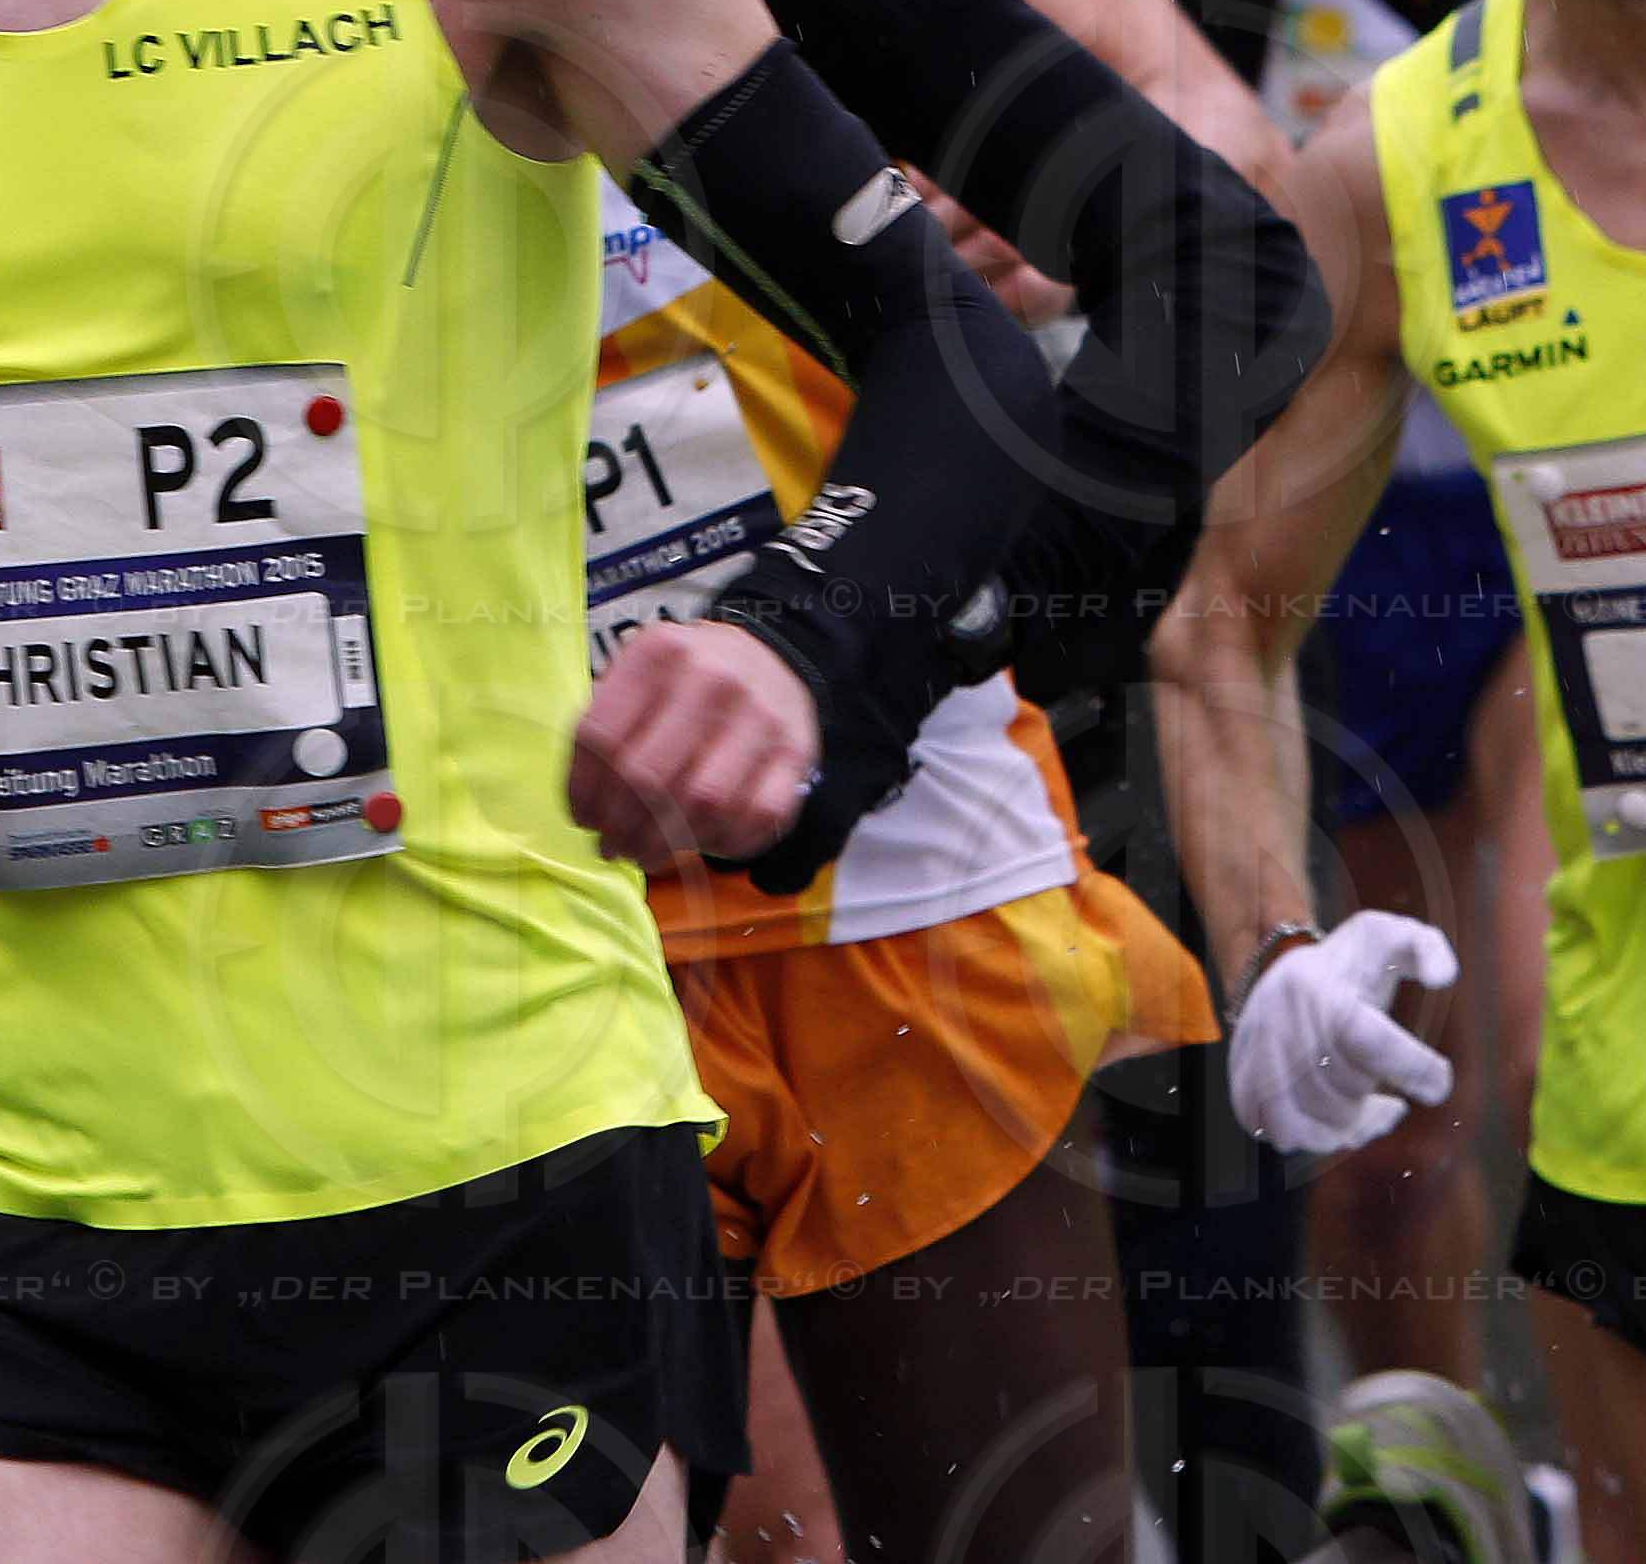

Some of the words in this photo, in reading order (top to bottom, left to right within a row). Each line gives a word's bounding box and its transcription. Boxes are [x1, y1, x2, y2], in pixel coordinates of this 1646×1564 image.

[103, 33, 166, 81] LC
[173, 1, 404, 70] VILLACH
[1434, 335, 1589, 386] GARMIN
[136, 415, 278, 531] P2
[585, 423, 674, 534] P1
[56, 573, 123, 602] GRAZ
[122, 560, 260, 597] MARATHON
[82, 751, 219, 790] Marathon
